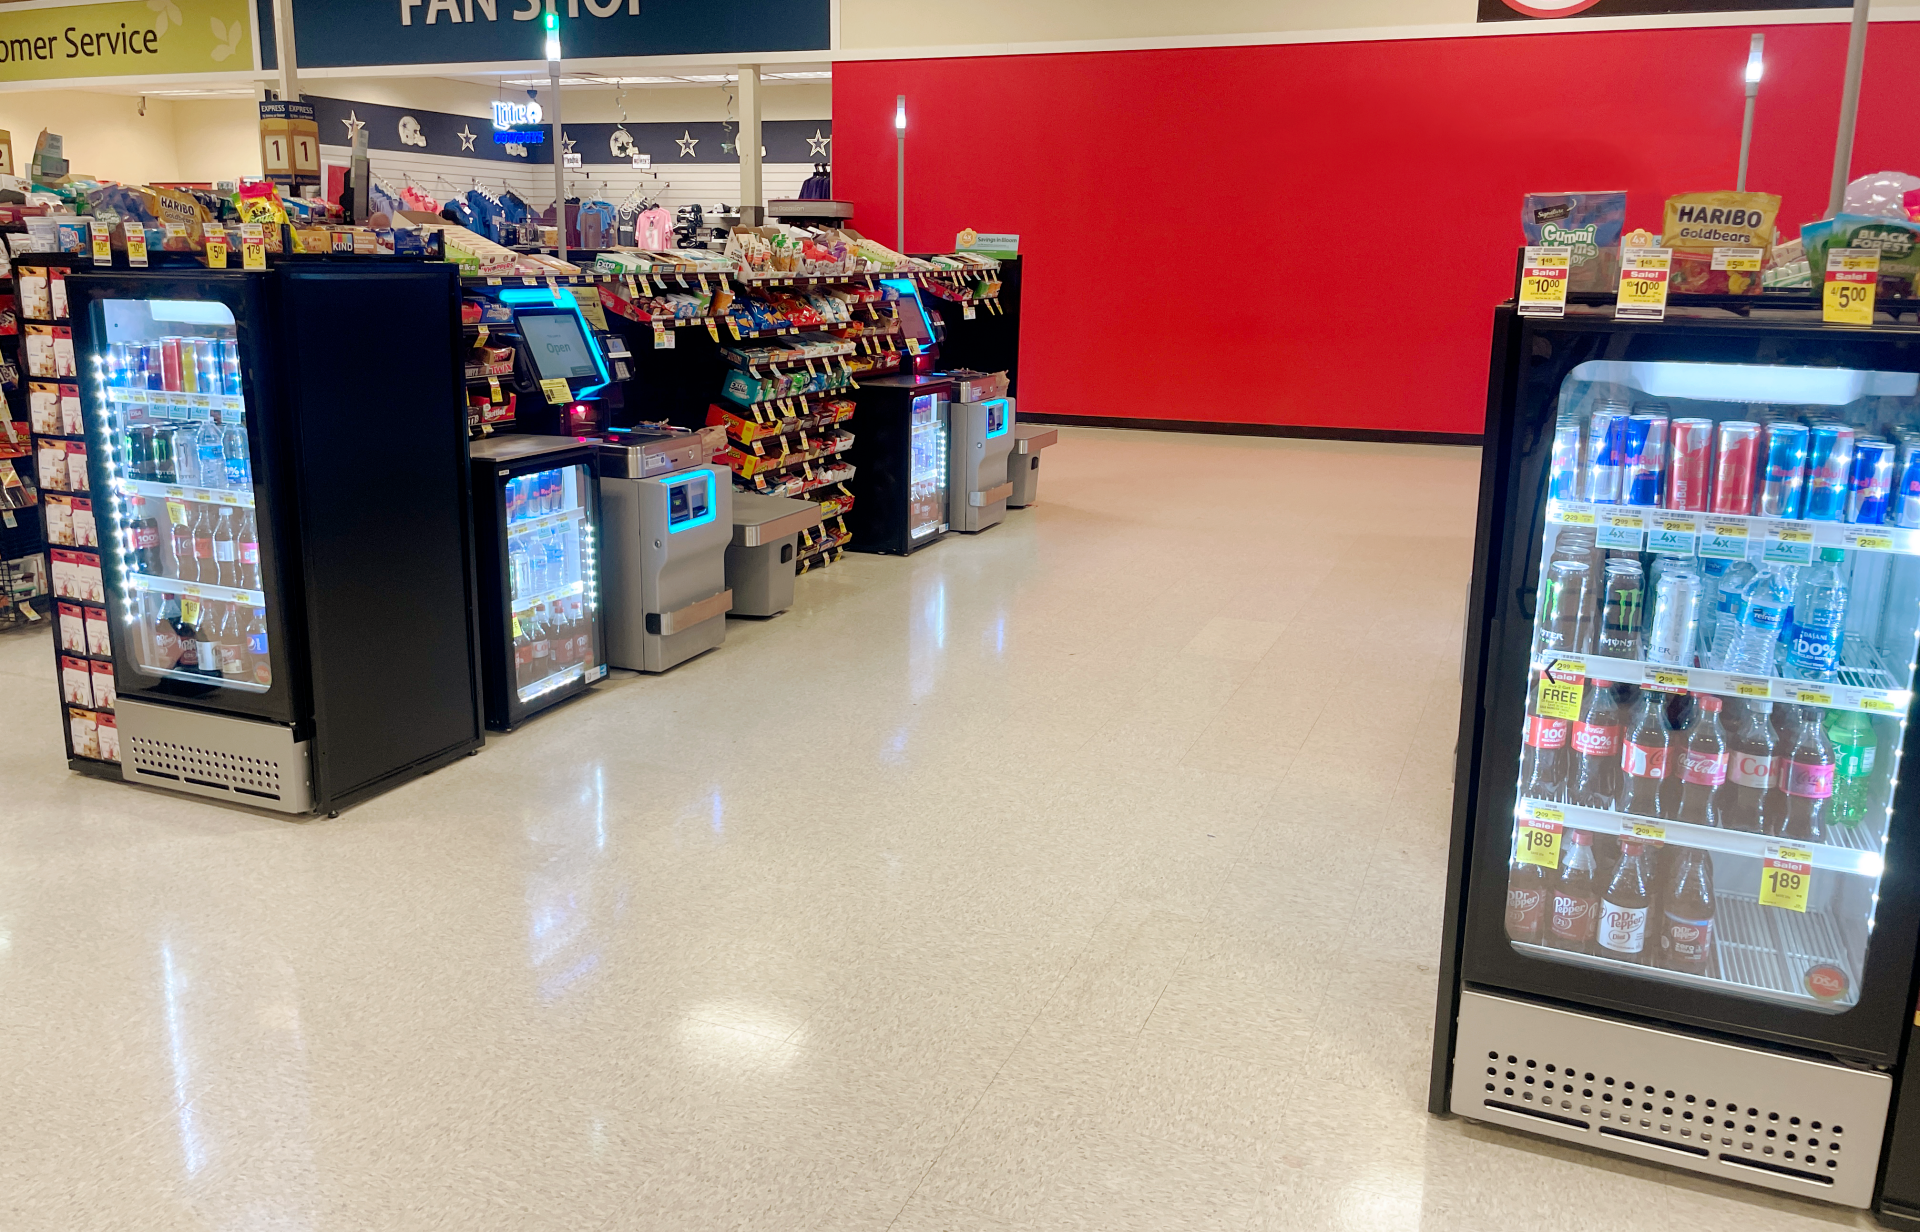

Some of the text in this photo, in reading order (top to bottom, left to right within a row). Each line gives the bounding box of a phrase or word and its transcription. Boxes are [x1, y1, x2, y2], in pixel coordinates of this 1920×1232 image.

[64, 23, 158, 59] Service
[261, 104, 286, 112] EXPRESS
[288, 104, 314, 114] EXPRESS
[272, 140, 281, 161] 1
[300, 141, 309, 162] 1
[161, 196, 195, 216] HARIBO
[1678, 205, 1763, 228] HARIBO
[1544, 224, 1596, 244] Gummi
[1631, 234, 1645, 244] 4x
[1680, 228, 1751, 243] Goldbears
[1858, 230, 1911, 243] BLACK
[332, 241, 353, 252] KIND
[1851, 239, 1912, 253] FOREST
[597, 258, 616, 270] Extra
[1532, 269, 1559, 277] Sale!
[1631, 271, 1659, 279] Sale!
[1835, 273, 1868, 281] Sale!
[546, 343, 572, 355] Open
[1614, 518, 1629, 526] 299
[1666, 522, 1681, 530] 299
[1608, 528, 1625, 539] 4x
[1718, 527, 1733, 535] 299
[1781, 532, 1797, 541] 299
[1660, 532, 1677, 543] 4x
[1712, 536, 1729, 548] 4x
[1775, 542, 1793, 553] 4x
[185, 601, 198, 615] 189
[1792, 638, 1837, 657] 100%
[1556, 662, 1571, 671] 299
[1550, 672, 1576, 682] Sale!
[1658, 675, 1673, 684] 299
[1543, 688, 1578, 704] FREE
[1542, 728, 1567, 739] 100
[1576, 731, 1612, 746] 100%
[1528, 819, 1555, 831] Sale!
[1635, 827, 1650, 836] 209
[1524, 830, 1553, 852] 189
[1781, 850, 1796, 859] 209
[1773, 860, 1803, 872] Sale!
[1768, 871, 1801, 894] 189
[1554, 896, 1588, 916] Pepper
[1562, 897, 1578, 907] Dr
[1608, 911, 1644, 930] Pepper
[1621, 911, 1636, 921] Dr
[1675, 942, 1694, 950] zero
[1812, 972, 1842, 989] DSA
